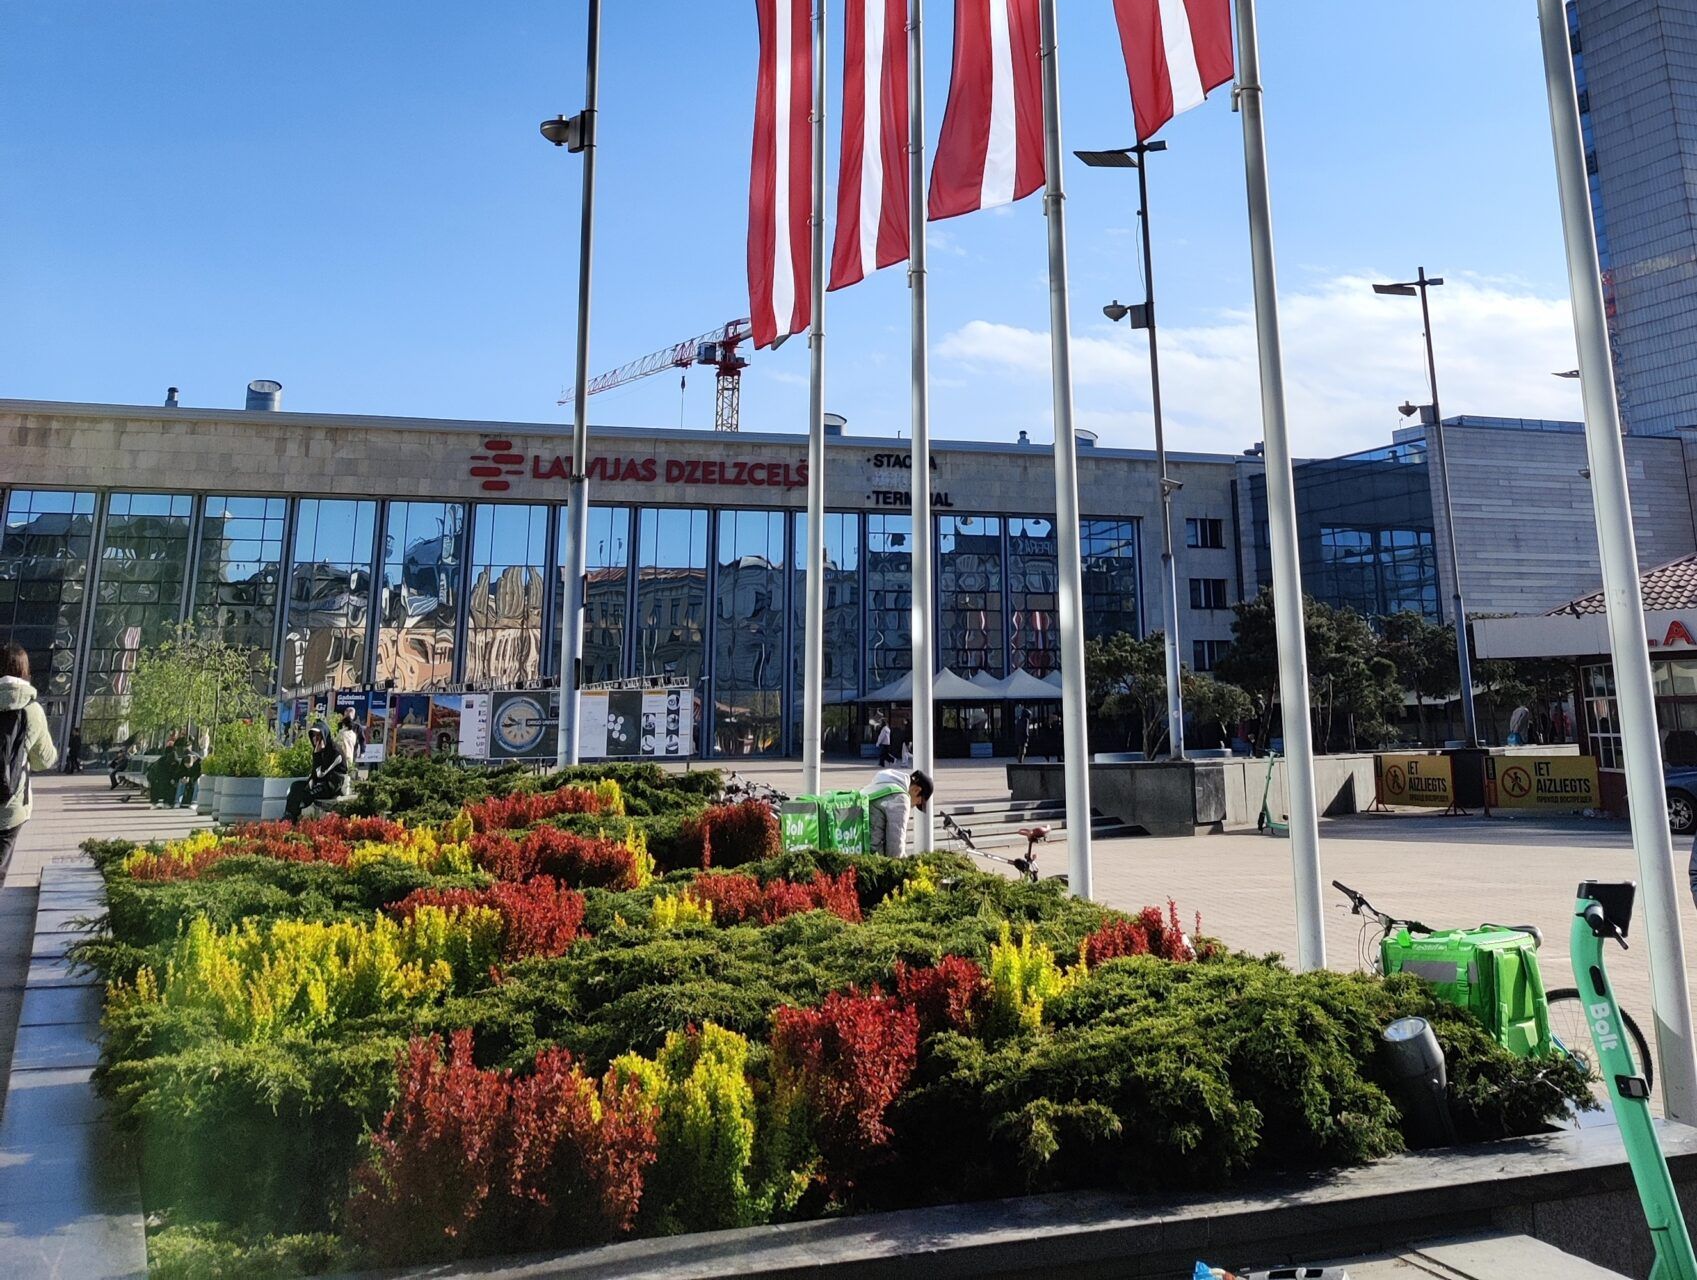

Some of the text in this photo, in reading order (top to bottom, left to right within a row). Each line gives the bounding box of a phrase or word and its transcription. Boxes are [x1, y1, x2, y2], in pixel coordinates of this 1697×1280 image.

[873, 453, 937, 470] STACA
[872, 490, 953, 507] TERAL
[1648, 619, 1697, 646] A
[1407, 761, 1419, 775] IET
[1534, 761, 1551, 776] IET
[1408, 777, 1447, 792] AIZLIEGTS
[1536, 778, 1591, 793] AIZLIEGTS
[1589, 1002, 1618, 1052] Bolt
